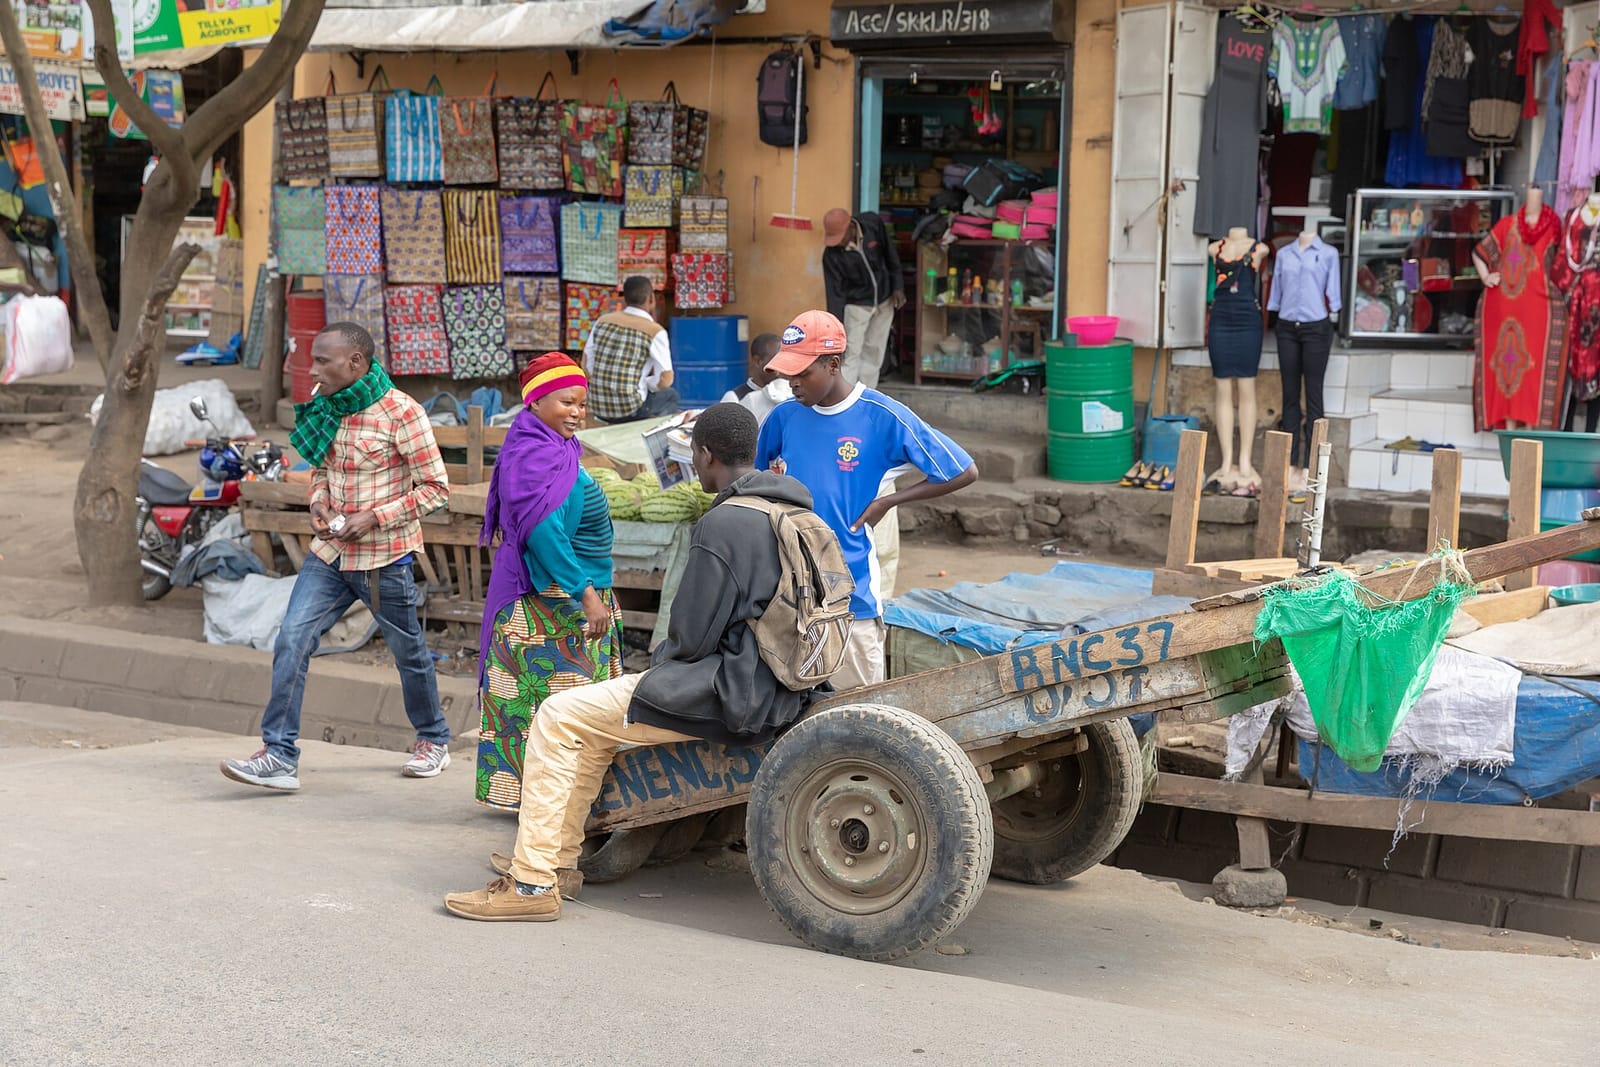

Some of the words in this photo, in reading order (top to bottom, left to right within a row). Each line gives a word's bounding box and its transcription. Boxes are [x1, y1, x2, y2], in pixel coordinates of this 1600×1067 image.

[197, 17, 235, 30] TILLYA
[199, 25, 252, 39] AGROVET
[1227, 36, 1265, 63] LOVE
